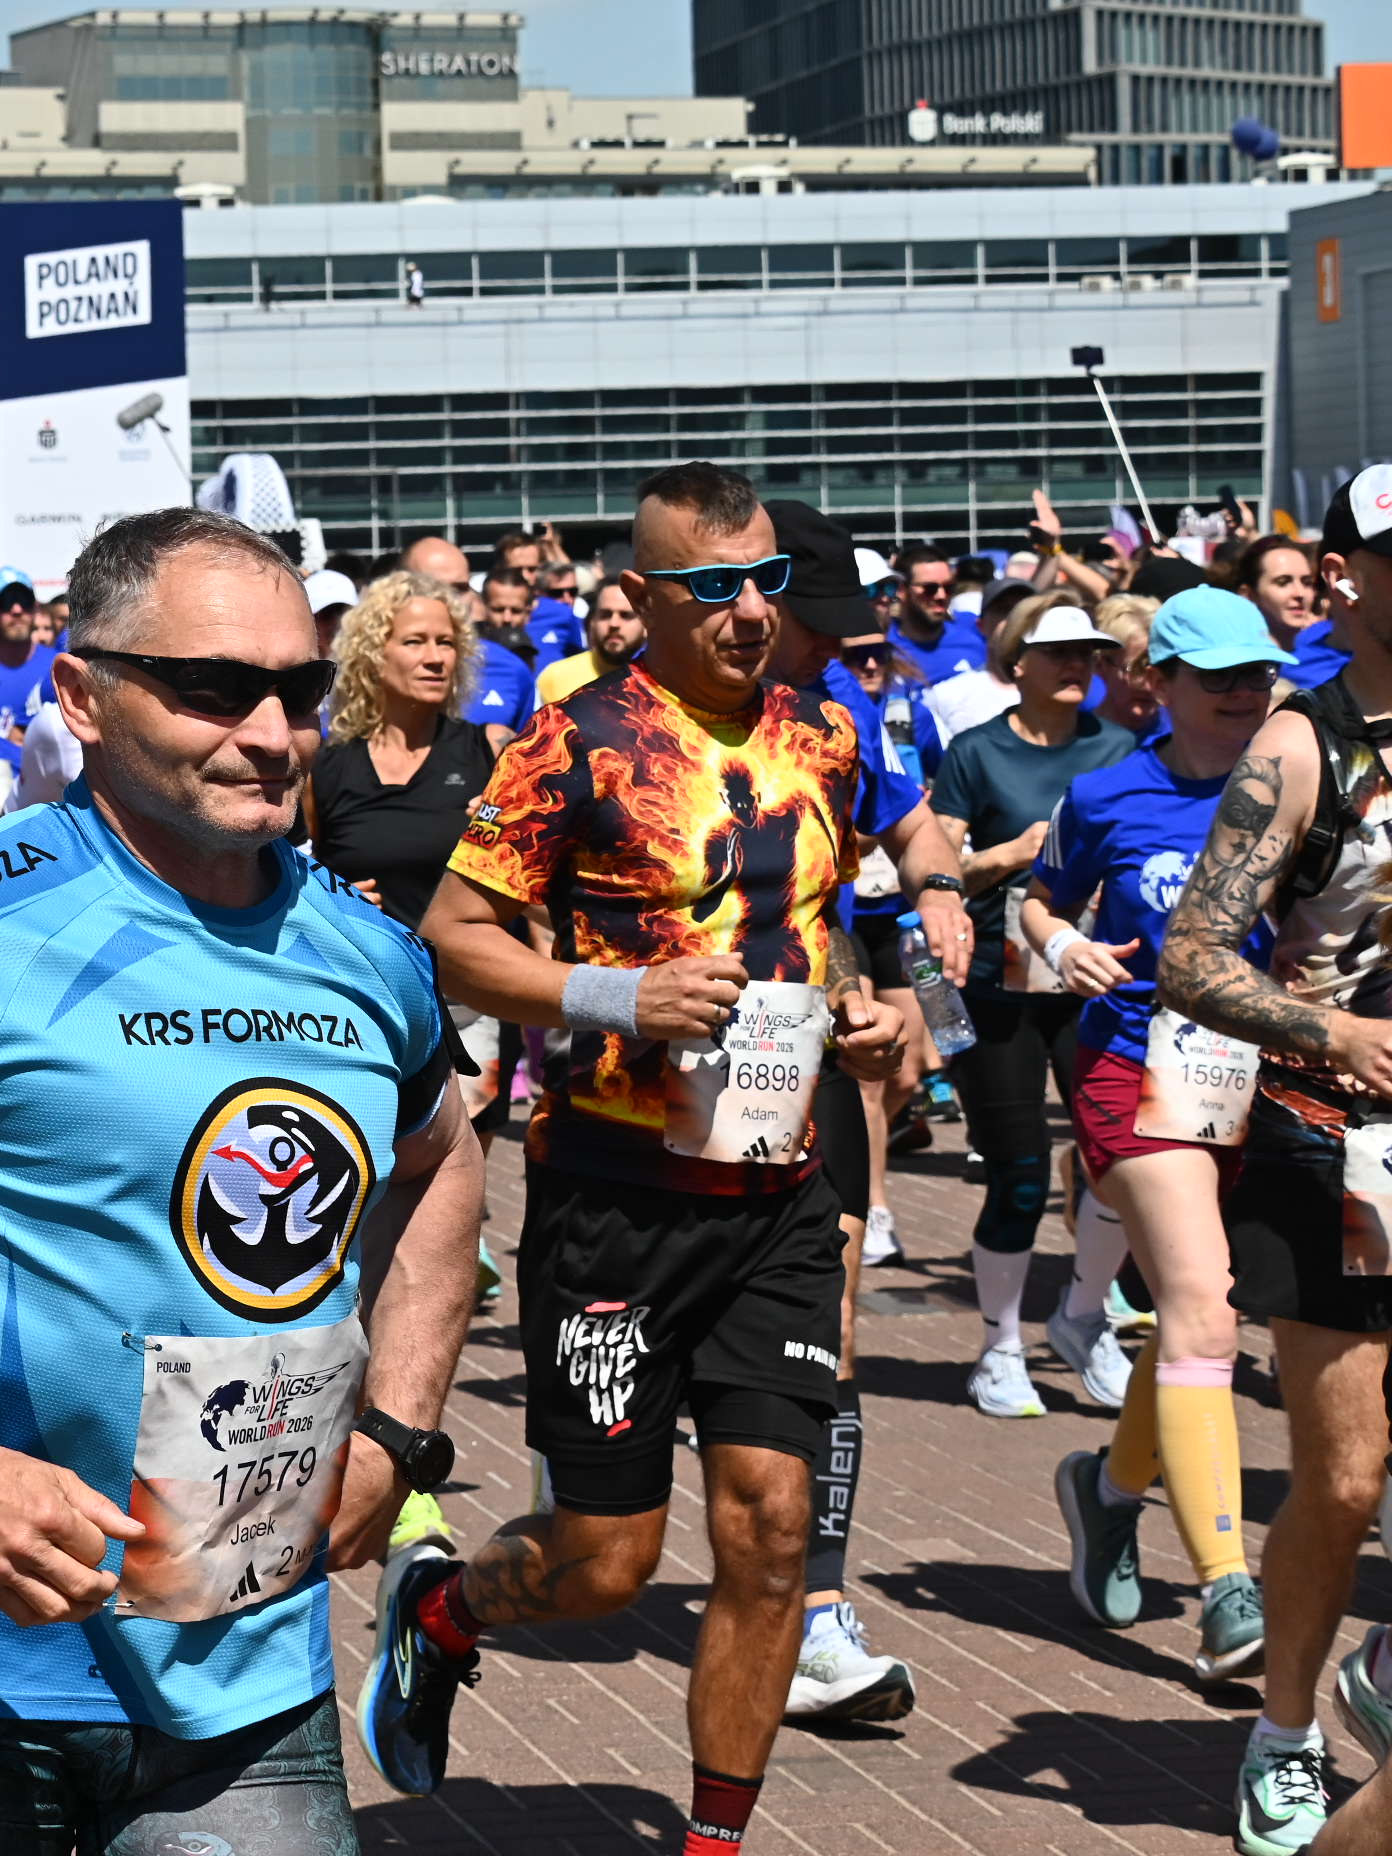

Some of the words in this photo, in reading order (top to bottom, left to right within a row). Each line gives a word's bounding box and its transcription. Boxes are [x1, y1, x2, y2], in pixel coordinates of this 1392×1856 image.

[381, 51, 521, 75] SHERATON
[943, 112, 985, 134] Bank
[990, 110, 1043, 134] Polski
[37, 251, 139, 291] POLAND
[38, 282, 139, 328] POZNAŃ
[118, 1010, 194, 1046] KRS
[201, 1008, 365, 1051] FORMOZA
[744, 1011, 792, 1028] WINGS
[749, 1025, 778, 1039] LIFE
[736, 1062, 800, 1092] 6898
[1181, 1062, 1247, 1091] 15976
[740, 1106, 779, 1121] Adam
[781, 1131, 792, 1153] 2
[1224, 1120, 1235, 1137] 3
[556, 1305, 651, 1367] NEVER
[784, 1340, 805, 1359] NO
[156, 1361, 191, 1374] POLAND
[569, 1343, 637, 1390] GIVE
[252, 1376, 316, 1404] WINGS
[588, 1375, 635, 1426] UP
[245, 1406, 260, 1415] FOR
[256, 1397, 289, 1423] LIFE
[228, 1424, 267, 1446] WORLD
[267, 1419, 286, 1439] RUN
[286, 1416, 313, 1434] 2026
[212, 1446, 317, 1506] 17579
[230, 1516, 276, 1546] Jacek
[275, 1545, 293, 1577] 2
